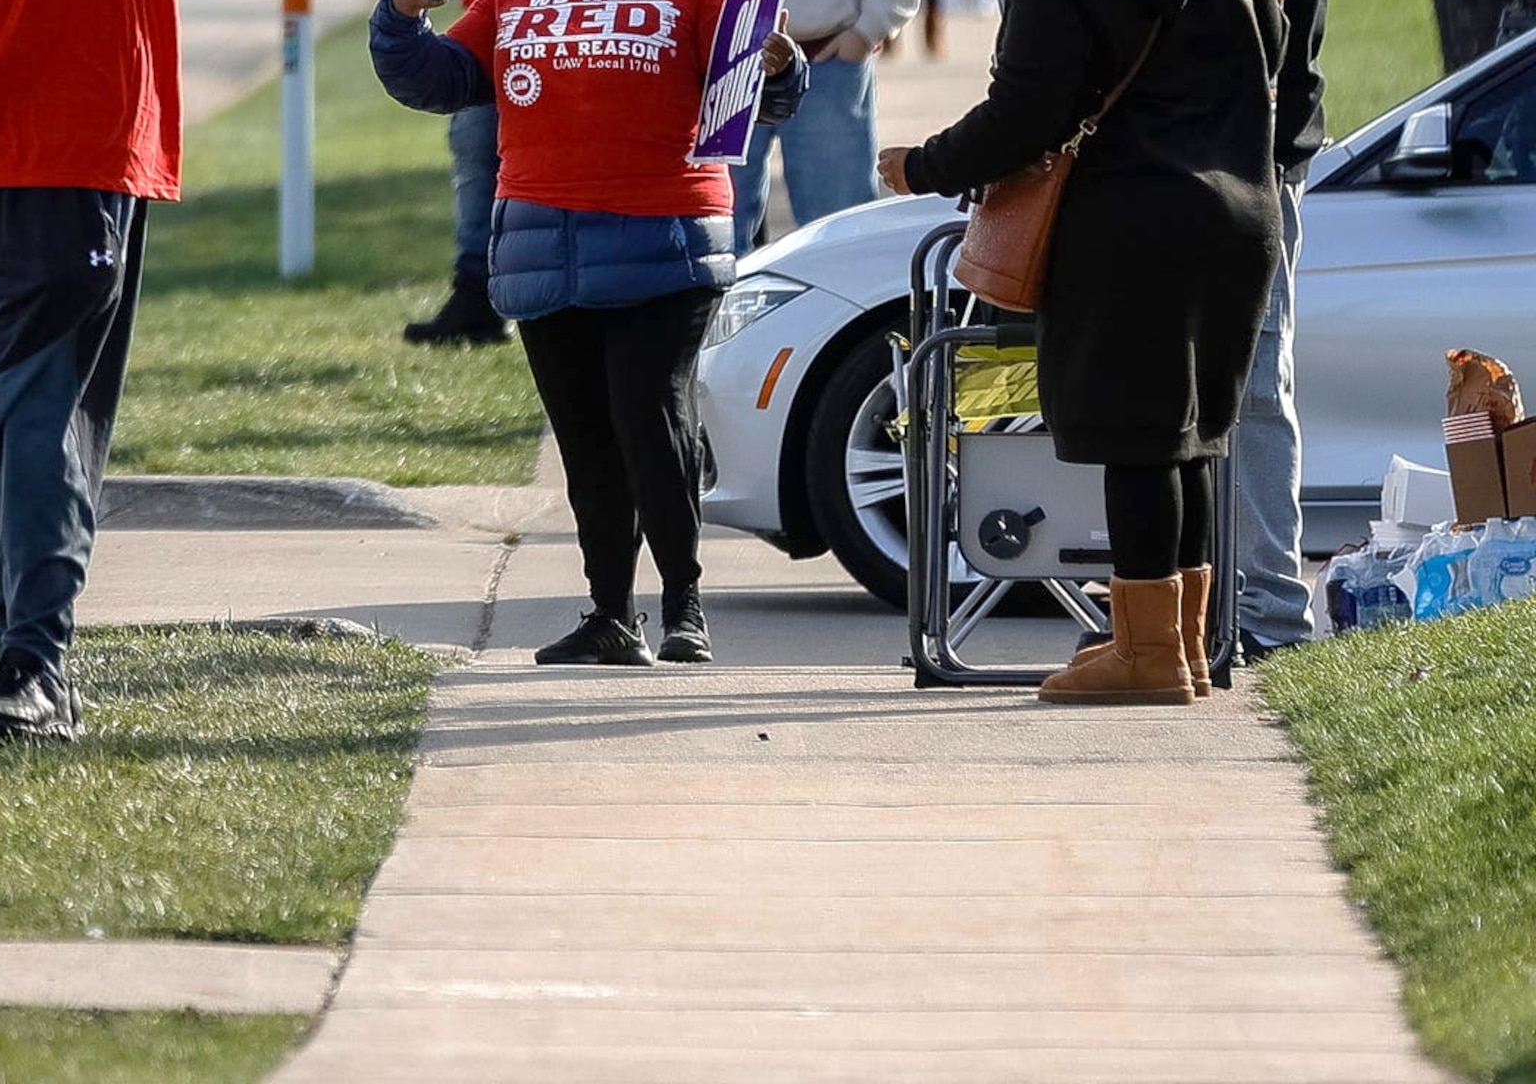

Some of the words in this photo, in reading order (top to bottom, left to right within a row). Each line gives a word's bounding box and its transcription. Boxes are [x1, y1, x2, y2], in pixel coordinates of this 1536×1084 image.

[512, 3, 662, 38] RED
[510, 45, 546, 61] FOR
[554, 42, 569, 57] A
[578, 41, 659, 61] REASON
[552, 58, 583, 70] UAW
[588, 58, 624, 70] Local
[629, 59, 660, 74] 1700
